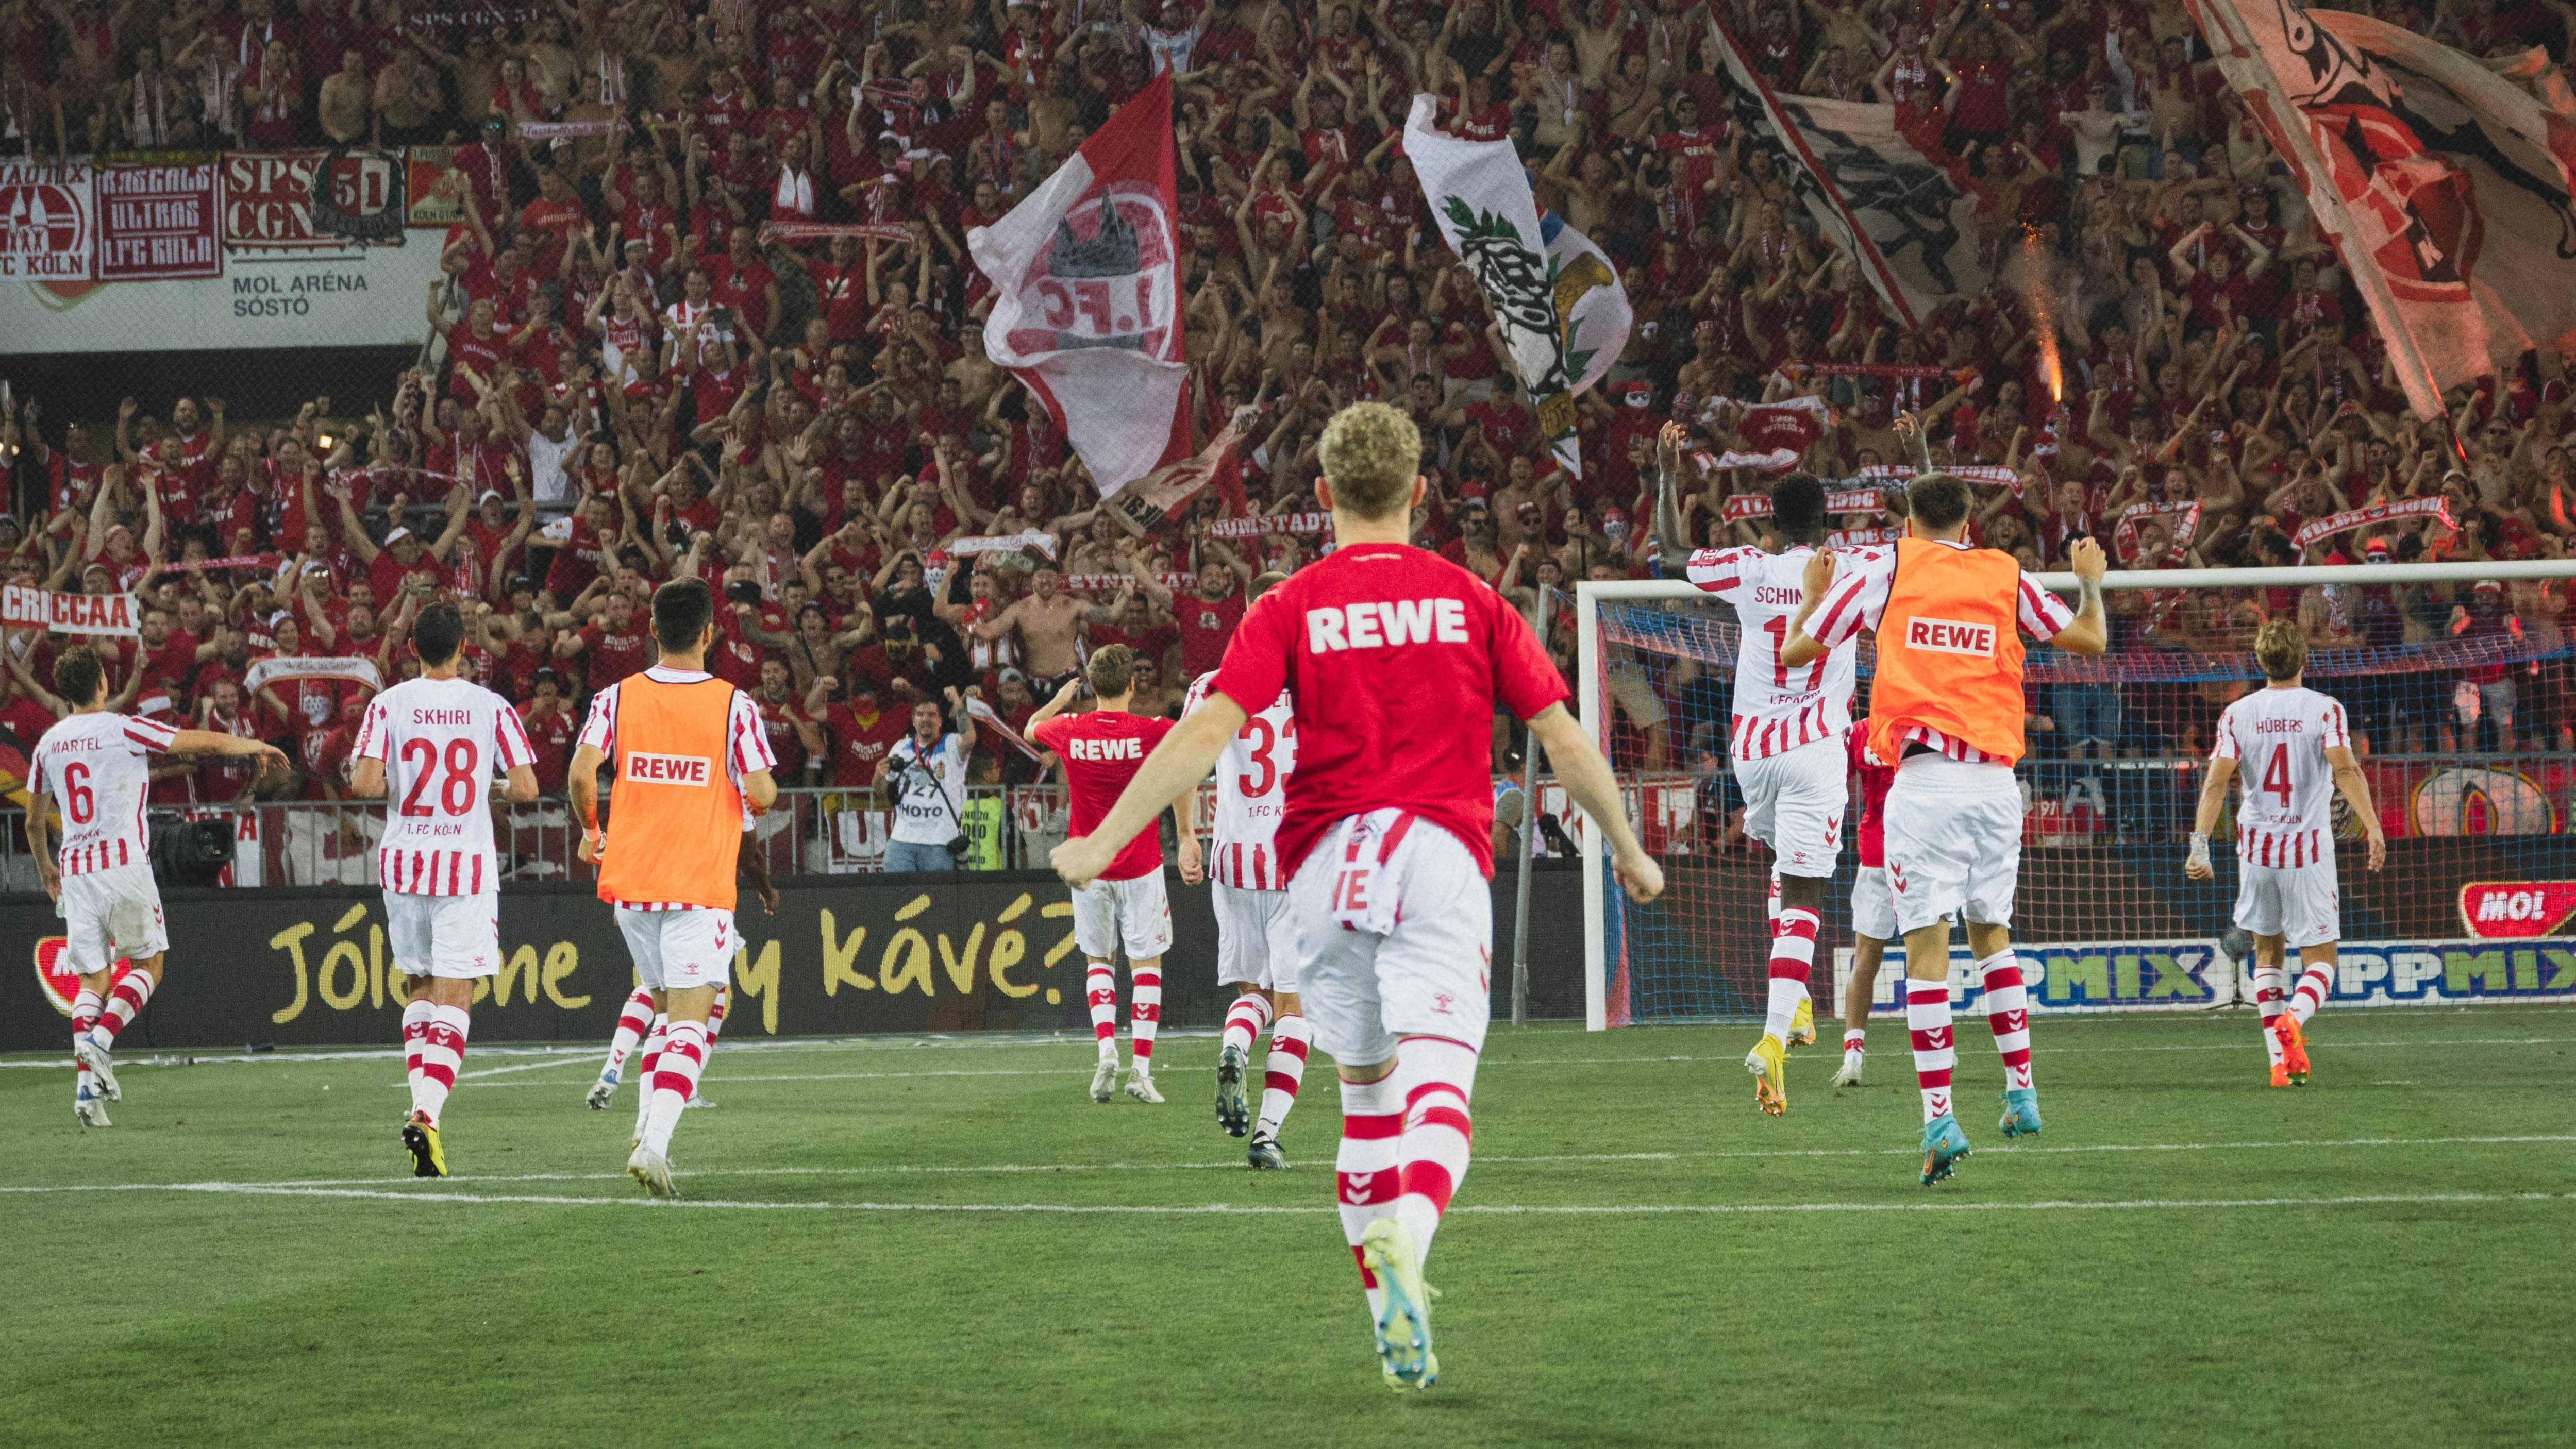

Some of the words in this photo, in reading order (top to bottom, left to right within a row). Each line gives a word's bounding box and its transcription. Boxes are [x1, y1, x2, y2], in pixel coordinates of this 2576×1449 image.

[0, 163, 86, 185] AUTIX
[229, 158, 314, 194] SPS
[335, 172, 383, 208] 51
[111, 200, 200, 230] ULTRAS
[228, 200, 314, 240] CGN
[27, 251, 83, 275] KÖLN
[233, 276, 282, 294] MOL
[290, 270, 368, 293] ARÉNA
[233, 294, 309, 317] SÓSTÓ
[576, 548, 603, 562] REW
[1068, 572, 1197, 589] SYNDAT
[1754, 586, 1803, 604] SCHIN
[52, 595, 131, 628] CCAA
[1306, 599, 1469, 654] REWE
[1911, 622, 1991, 652] REWE
[413, 708, 471, 726] SKHIRI
[2256, 717, 2304, 734] HÜBERS
[51, 737, 103, 753] MARTEL
[1070, 737, 1143, 760] REWE
[400, 737, 478, 817] 28
[631, 756, 705, 782] REWE
[2262, 743, 2294, 808] 4
[64, 762, 94, 824] 6
[900, 804, 943, 818] HOTO
[407, 823, 429, 836] 1.FC
[433, 822, 462, 836] KÖLN
[2478, 891, 2545, 922] MOL
[270, 902, 384, 1024] Jól
[821, 892, 1075, 1006] kávé?
[1855, 948, 2208, 1005] TPMIX
